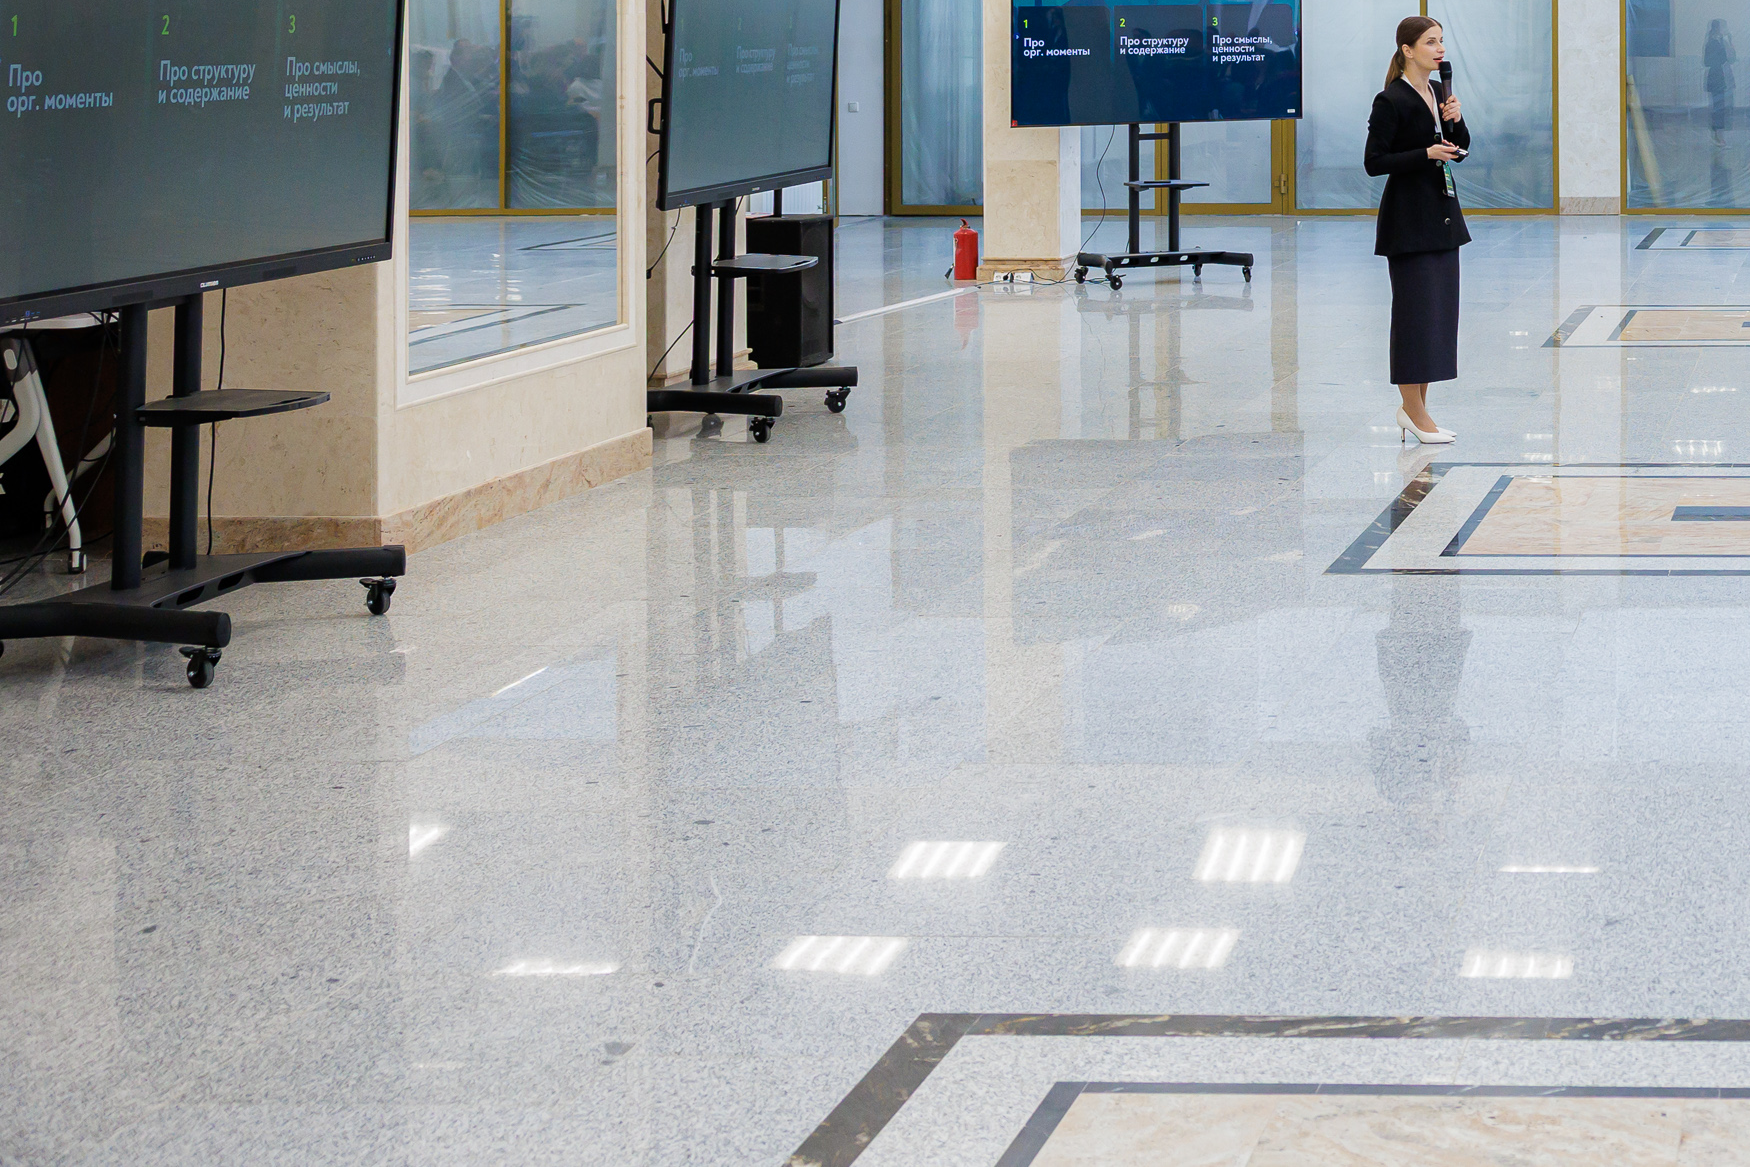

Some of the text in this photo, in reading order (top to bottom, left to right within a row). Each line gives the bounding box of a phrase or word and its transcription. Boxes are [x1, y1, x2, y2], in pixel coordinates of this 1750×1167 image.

[11, 14, 18, 37] 1
[161, 14, 170, 35] 2
[288, 14, 296, 34] 3
[1023, 19, 1028, 29] 1
[1119, 18, 1126, 28] 2
[1212, 17, 1218, 26] 3
[1023, 37, 1045, 50] Про
[1119, 36, 1189, 48] Про структуру
[1212, 34, 1273, 46] Про смыслы,
[679, 47, 693, 67] Про
[1023, 48, 1090, 59] орг. моменты
[1119, 46, 1186, 57] и содержание
[1212, 46, 1255, 54] ценности
[286, 56, 360, 81] Про смыслы,
[1212, 54, 1265, 65] и результат
[9, 63, 43, 94] Про
[159, 60, 256, 87] Про структуру
[158, 85, 250, 108] и содержание
[285, 82, 338, 100] ценности
[7, 92, 113, 118] орг. моменты
[283, 101, 350, 123] и результат
